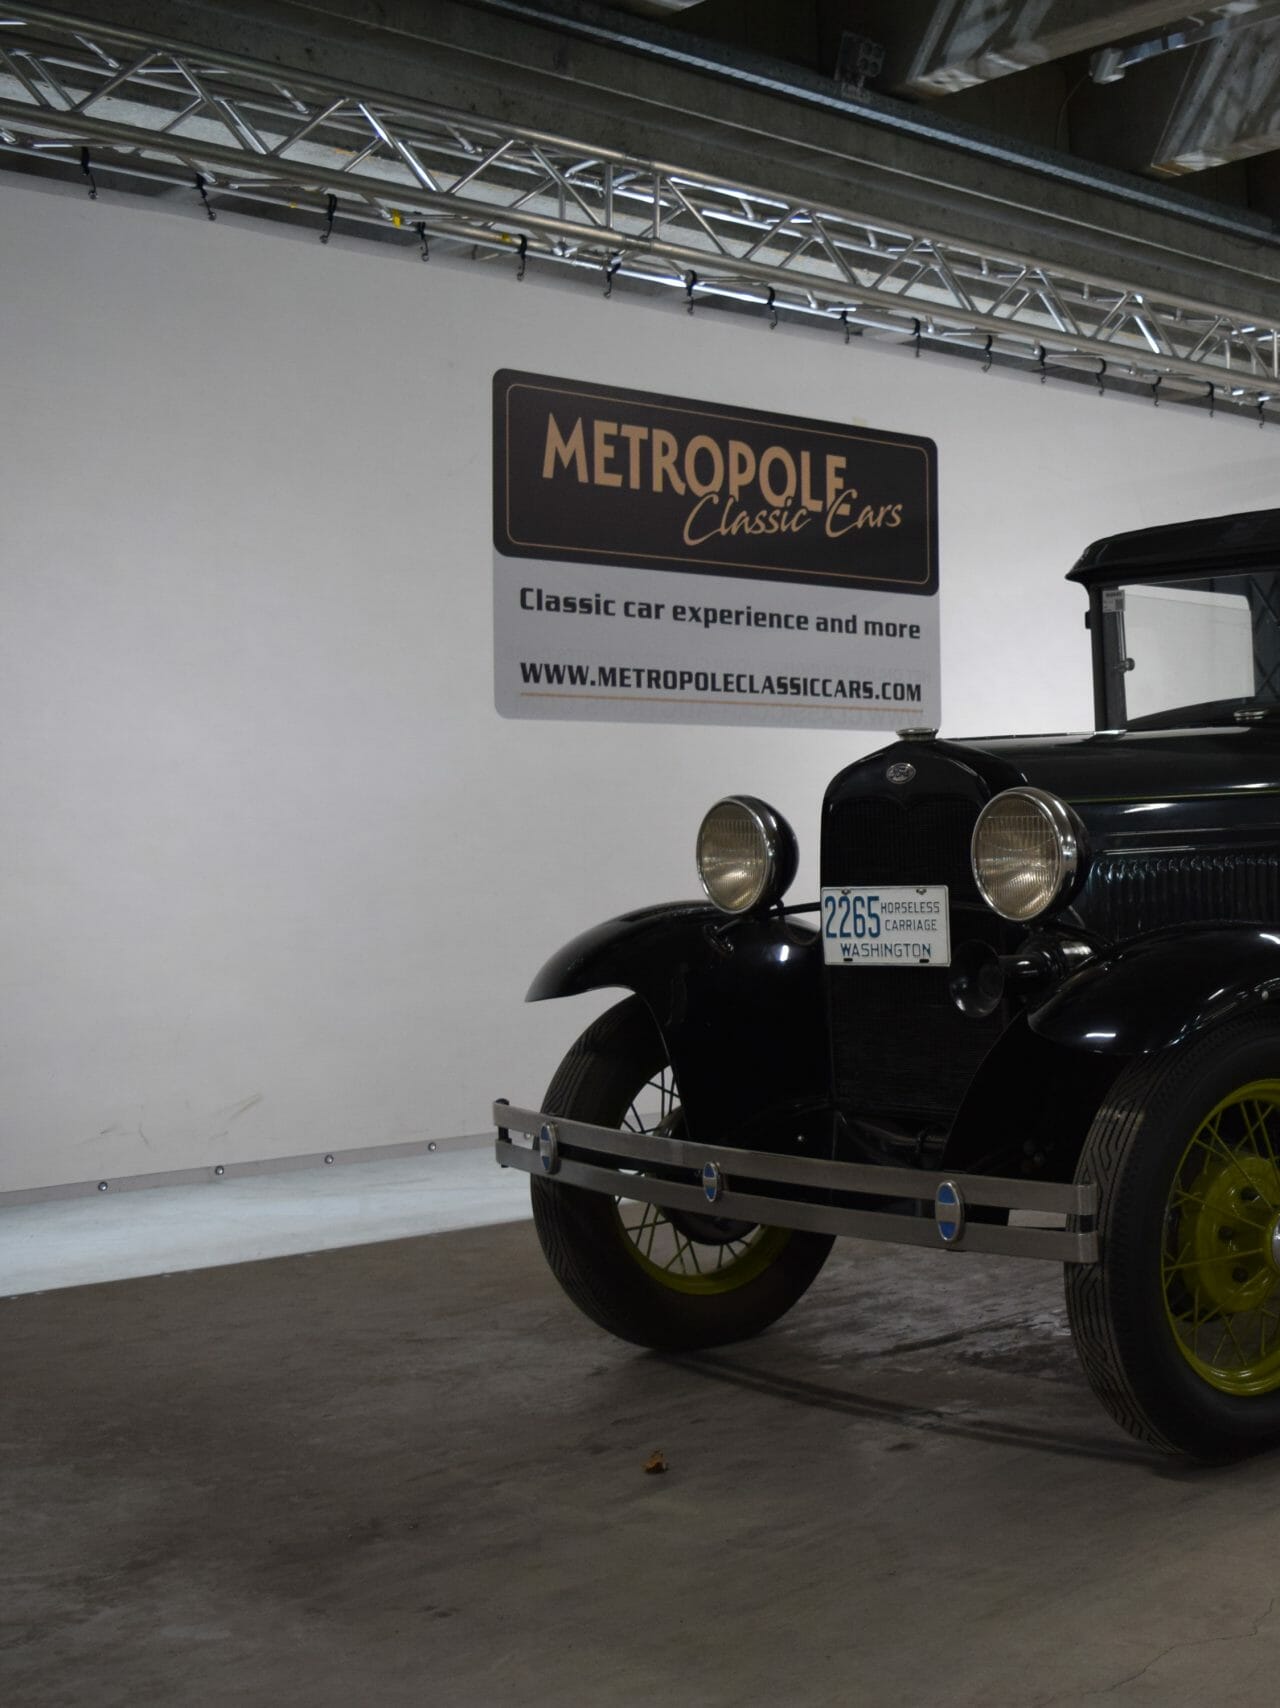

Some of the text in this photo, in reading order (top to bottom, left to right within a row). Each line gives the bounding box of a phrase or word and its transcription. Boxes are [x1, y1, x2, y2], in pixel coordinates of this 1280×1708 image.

[542, 412, 850, 516] METROPOLE
[683, 489, 903, 546] Classic Cars
[520, 587, 921, 640] Classic car experience and more
[520, 662, 922, 702] WWW.METROPOLECLASSICCARS.COM
[825, 895, 881, 939] 2265
[880, 901, 940, 914] HORSELESS
[885, 919, 938, 932] CARRIAGE
[840, 943, 932, 958] WASHINGTON
